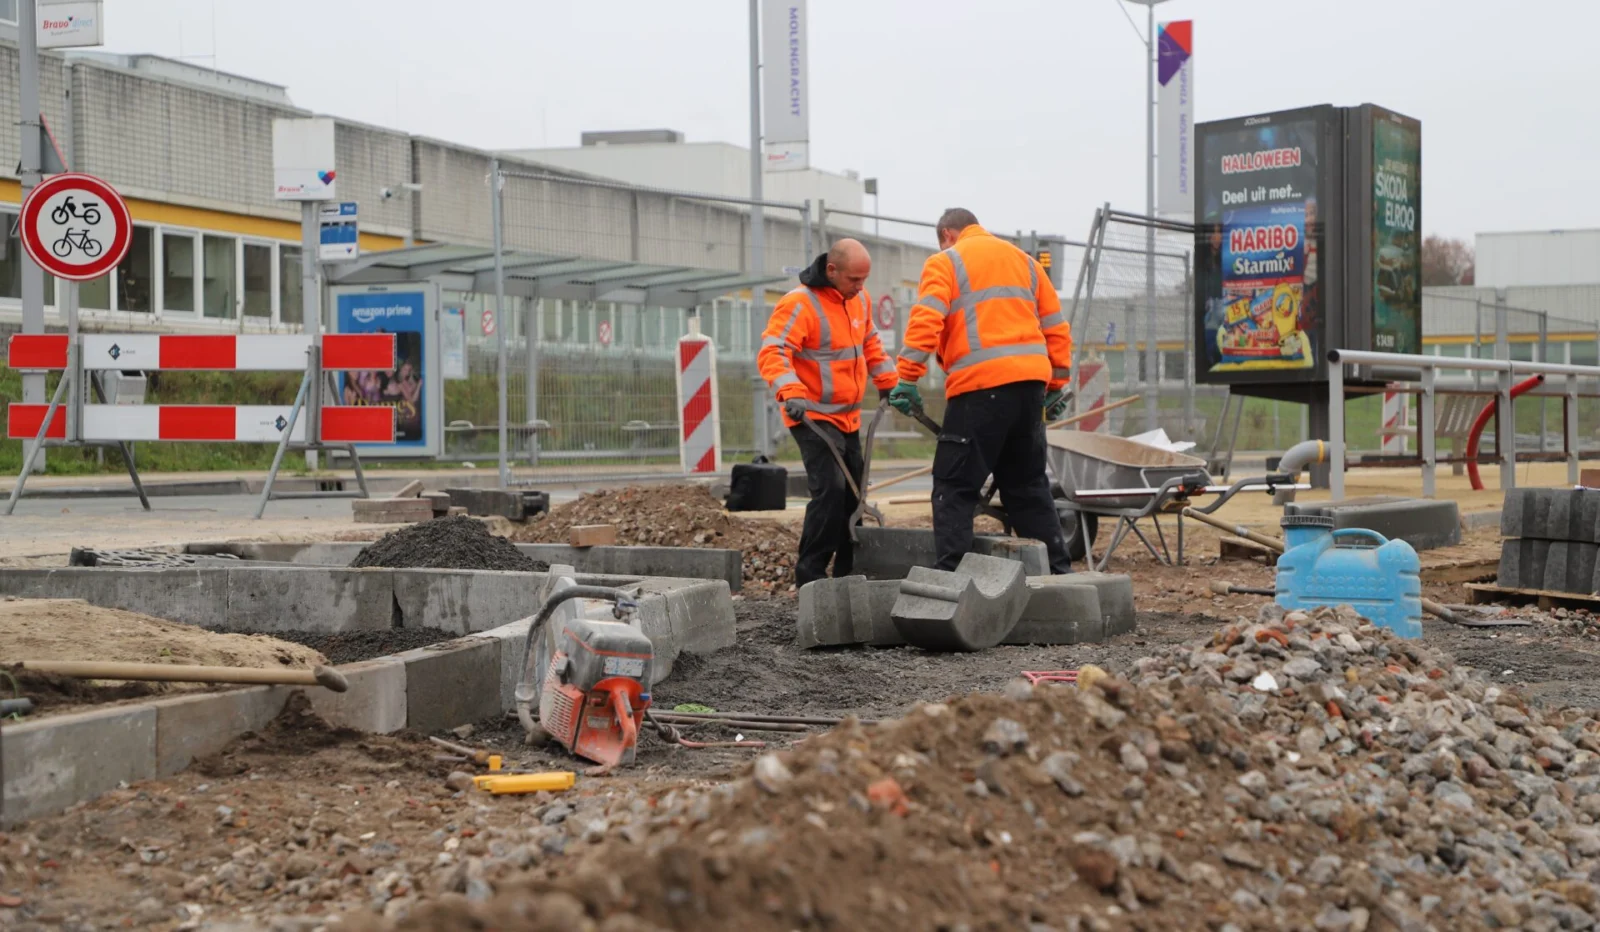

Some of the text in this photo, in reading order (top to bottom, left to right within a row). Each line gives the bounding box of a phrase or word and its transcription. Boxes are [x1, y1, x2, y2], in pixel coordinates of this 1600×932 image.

[43, 20, 69, 30] Bravo
[789, 7, 801, 116] MOLENGRACHT
[1222, 147, 1301, 174] HALLOWEEN
[1222, 184, 1302, 205] Deel uit met...
[1375, 165, 1408, 203] ŠKODA
[1385, 201, 1415, 232] ELROQ
[1230, 225, 1299, 254] HARIBO
[1234, 257, 1291, 275] Starmix
[352, 304, 412, 319] amazon prime
